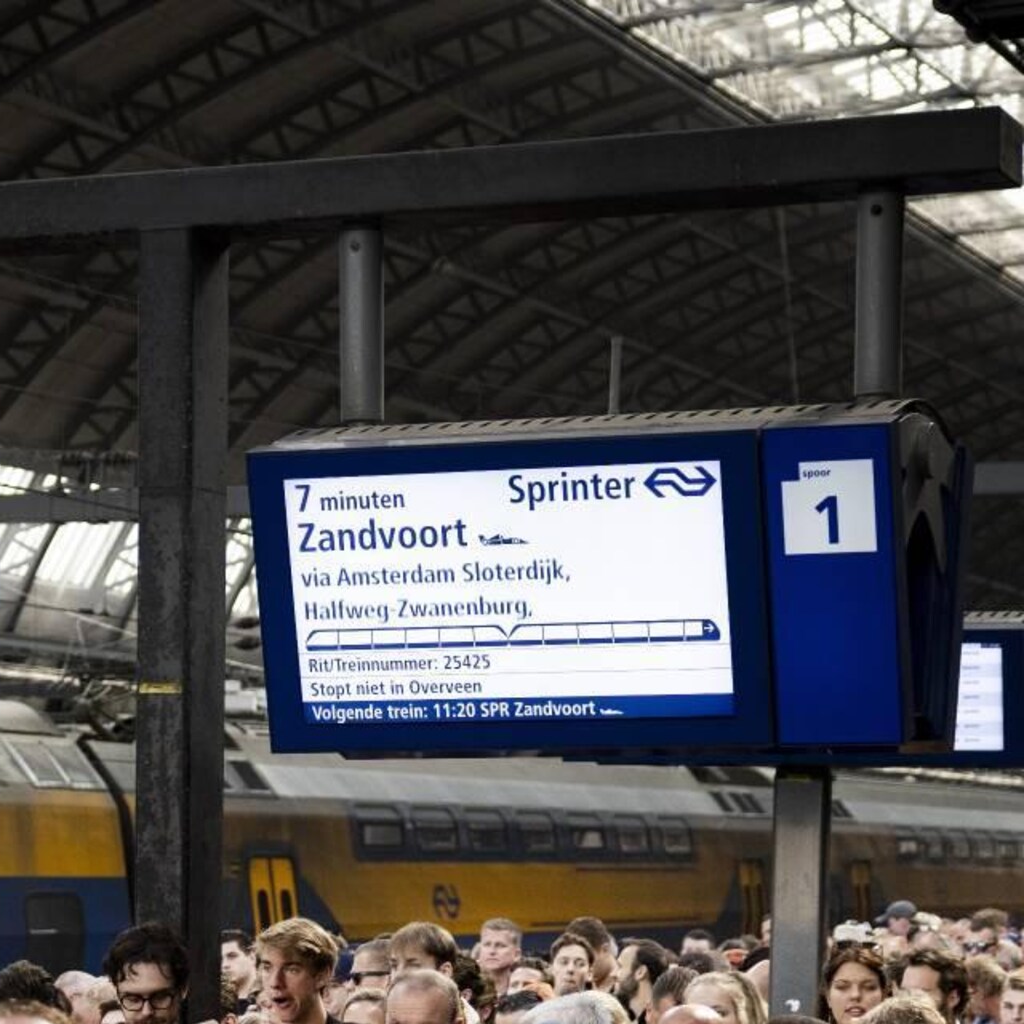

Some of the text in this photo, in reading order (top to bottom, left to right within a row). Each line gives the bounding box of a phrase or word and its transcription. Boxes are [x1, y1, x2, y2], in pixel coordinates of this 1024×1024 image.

[802, 468, 832, 479] spoor
[294, 484, 406, 512] 7 minuten
[508, 471, 636, 511] Sprinter
[814, 495, 839, 545] 1
[297, 517, 468, 552] Zandvoort
[301, 558, 571, 588] via Amsterdam Sloterdijk,
[304, 596, 533, 623] Halfweg-Zwanenburg,
[308, 654, 491, 673] Rit/Treinnummer: 25425
[310, 680, 482, 699] Stopt niet in Overveen
[311, 700, 596, 724] Volgende trein: 11:20 SPR Zandvoort
